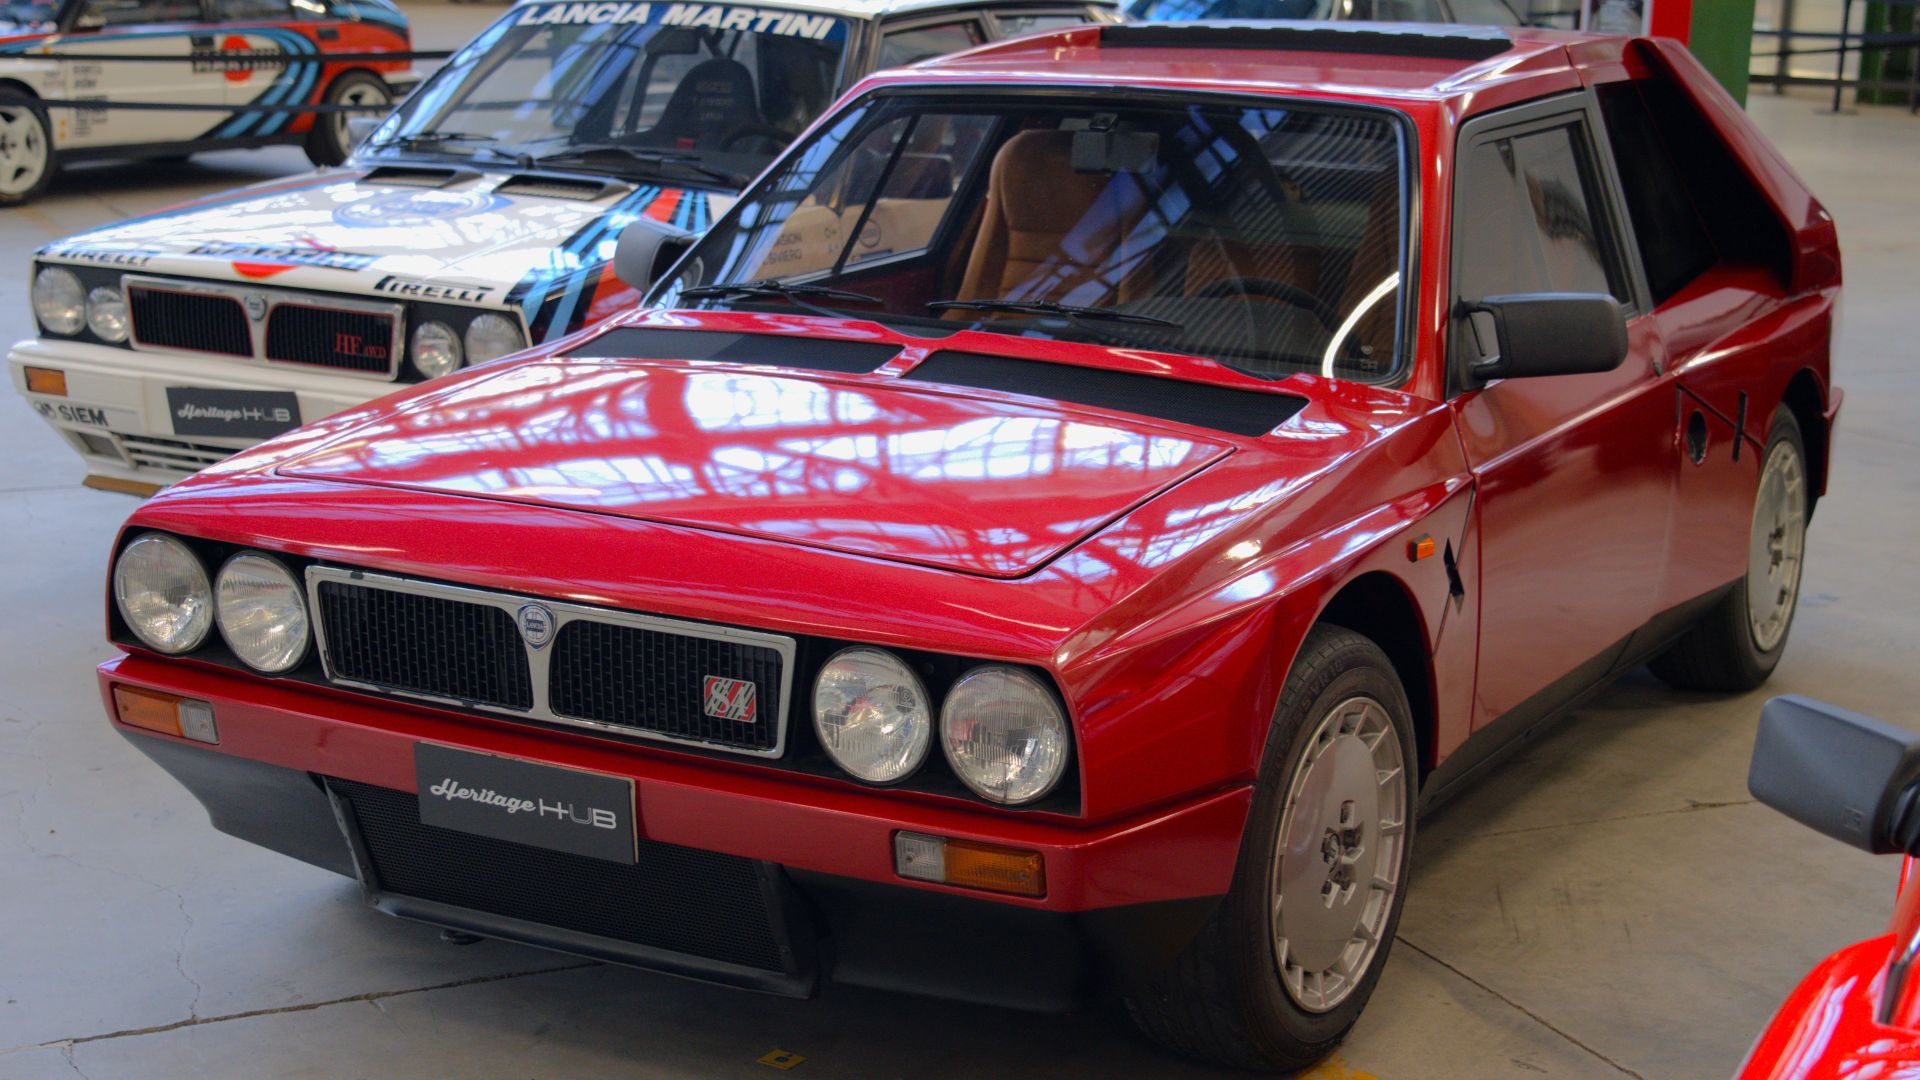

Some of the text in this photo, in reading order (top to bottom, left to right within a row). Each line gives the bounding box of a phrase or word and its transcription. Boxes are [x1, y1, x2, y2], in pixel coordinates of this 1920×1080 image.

[517, 2, 836, 40] LANCIA MARTINI
[374, 275, 495, 302] PIRELLI
[335, 331, 362, 355] HF
[58, 404, 109, 427] SIEM
[178, 403, 291, 423] Heritage HUB
[430, 778, 617, 830] Heritage HUB
